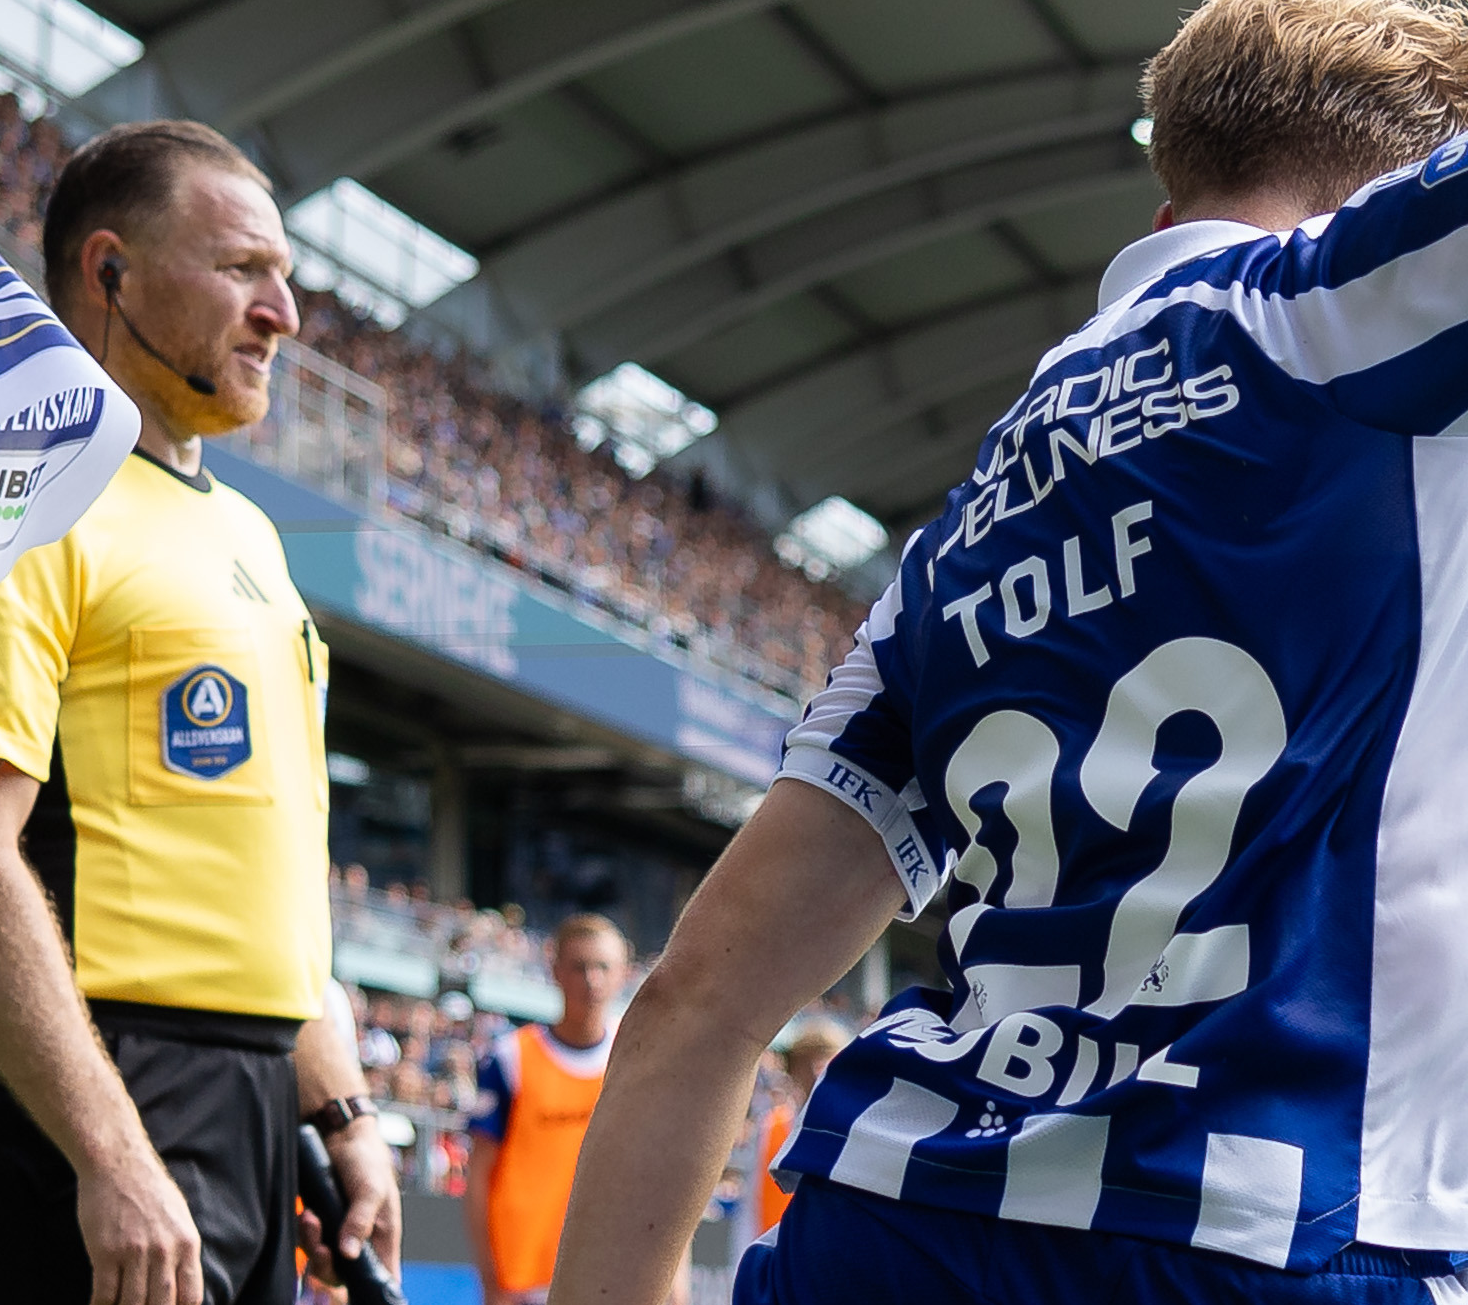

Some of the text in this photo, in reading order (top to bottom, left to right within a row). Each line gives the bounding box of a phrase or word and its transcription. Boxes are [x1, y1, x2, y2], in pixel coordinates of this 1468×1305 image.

[941, 499, 1153, 667] TOLF
[824, 761, 882, 814] IFK
[945, 635, 1288, 1035] 22
[894, 833, 930, 888] IFK
